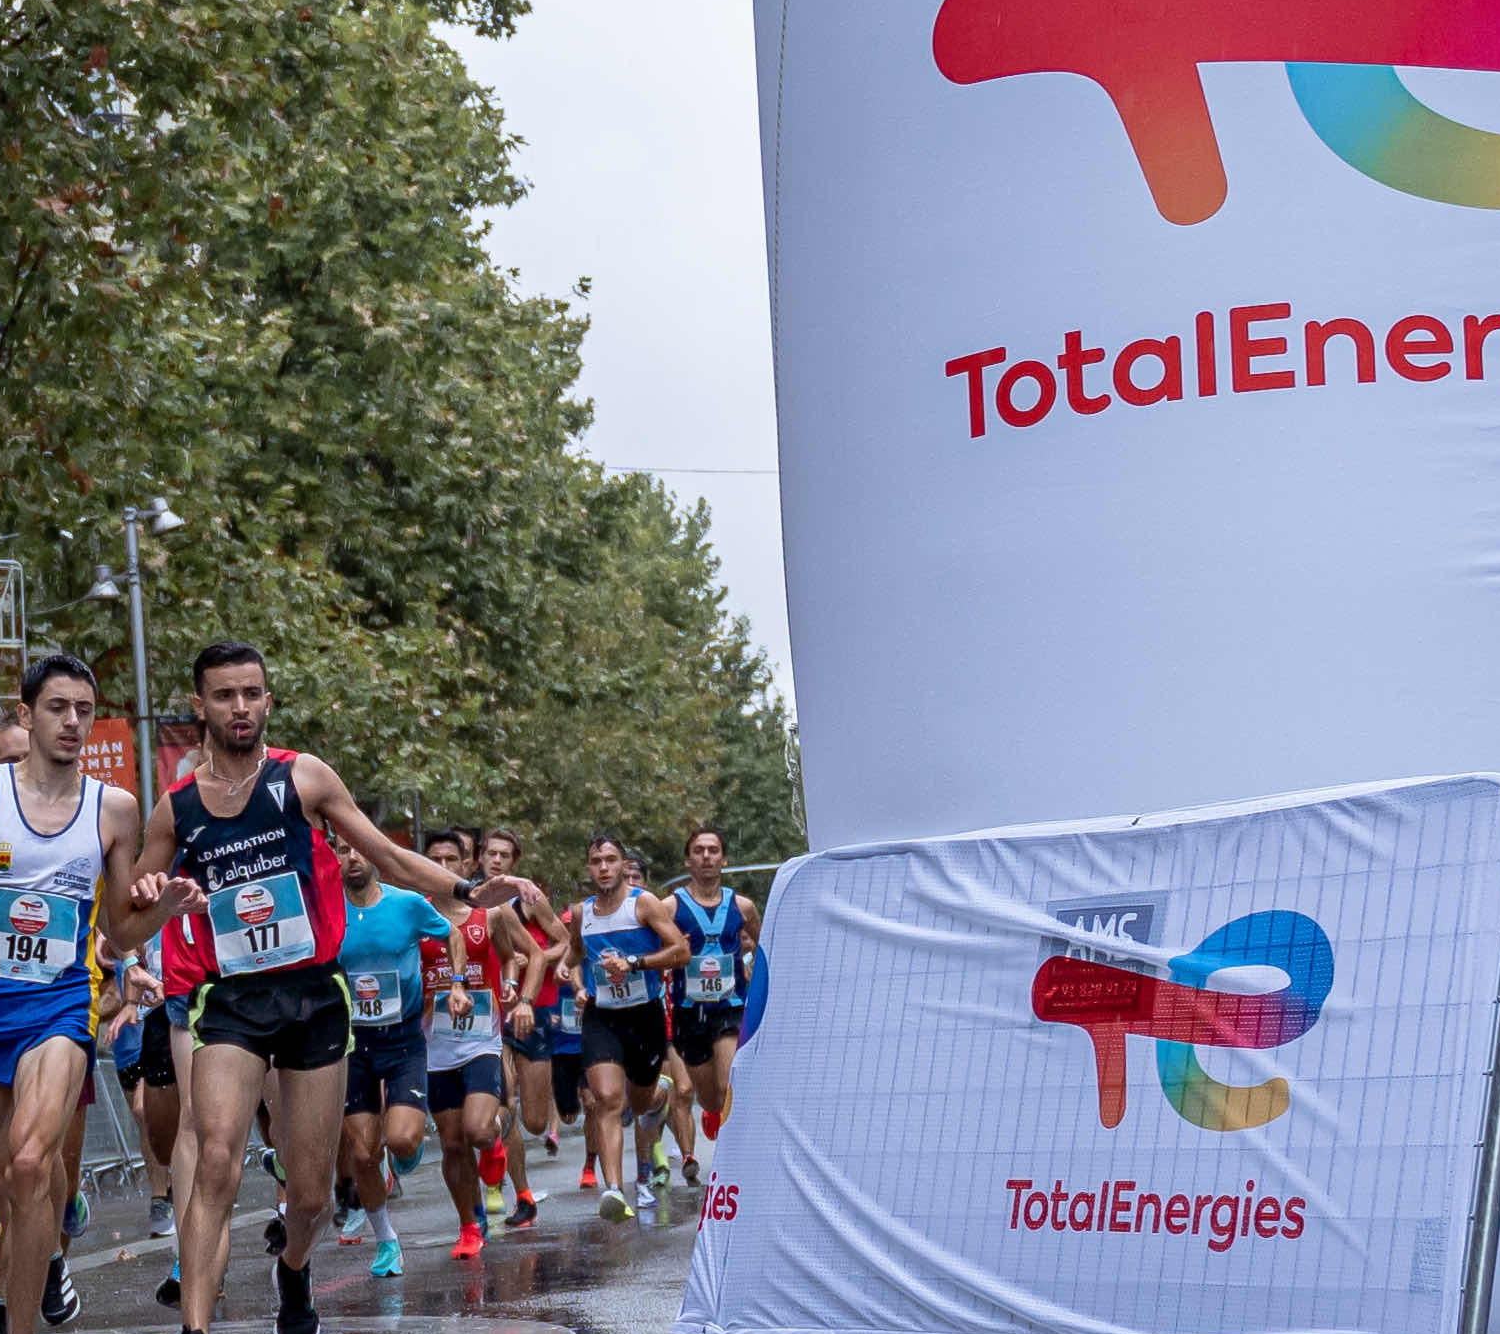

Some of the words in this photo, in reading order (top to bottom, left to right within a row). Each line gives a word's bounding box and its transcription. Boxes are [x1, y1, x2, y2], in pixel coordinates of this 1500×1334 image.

[225, 853, 288, 882] alquiber
[6, 934, 48, 964] 194
[244, 922, 280, 953] 177
[609, 983, 631, 999] 151
[700, 978, 722, 993] 146
[357, 999, 383, 1018] 148
[1006, 1179, 1306, 1253] TotalEnergies
